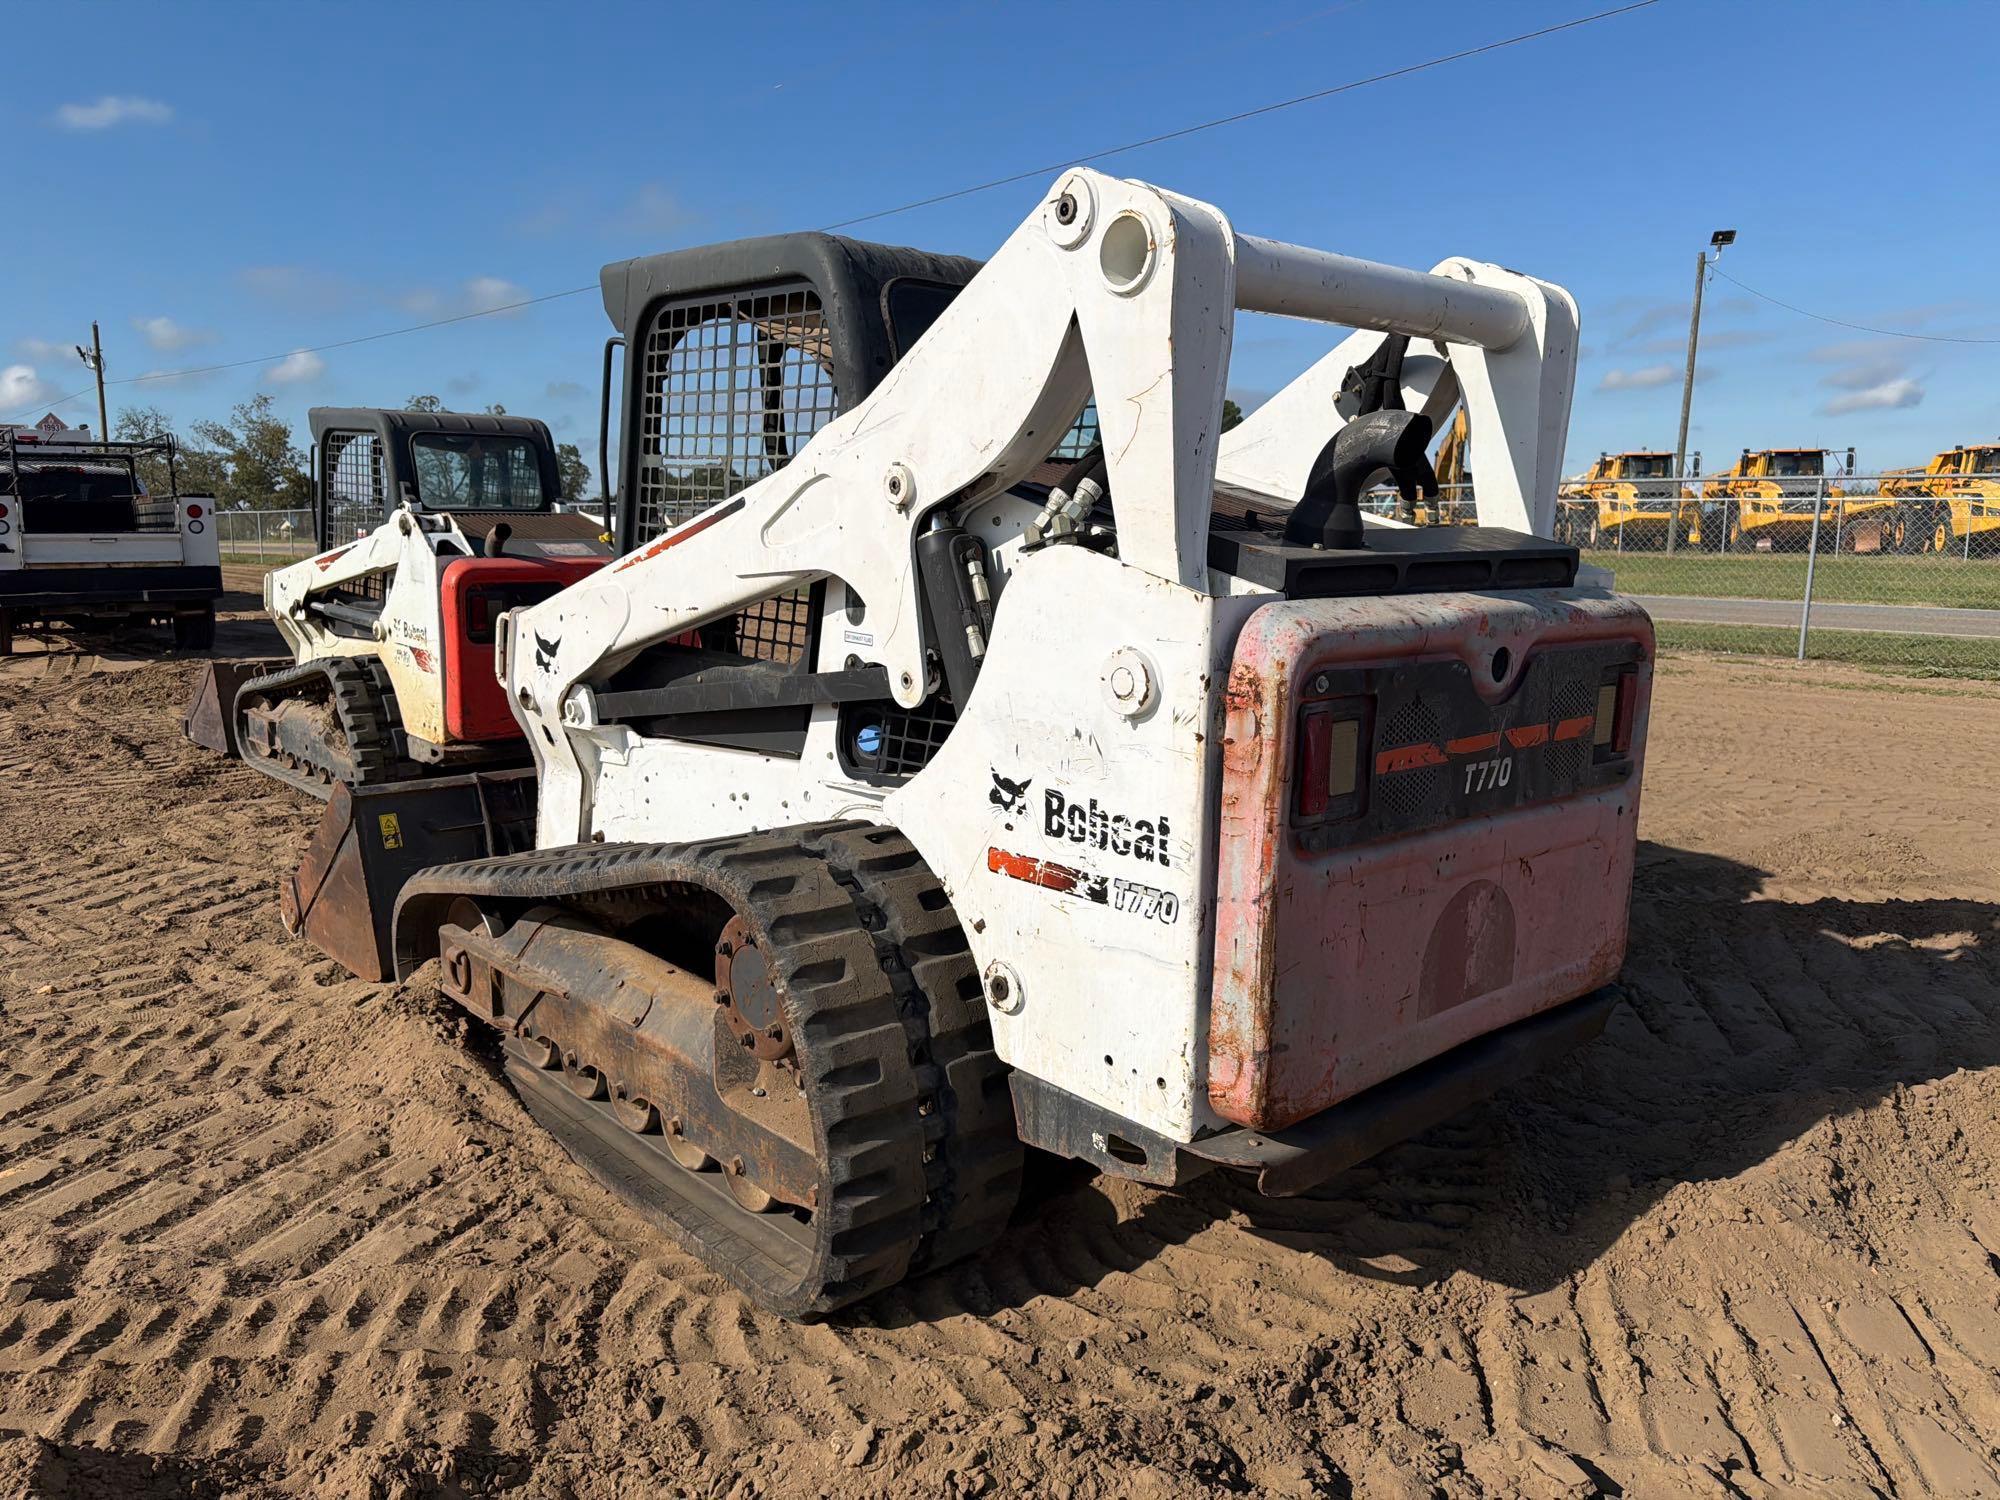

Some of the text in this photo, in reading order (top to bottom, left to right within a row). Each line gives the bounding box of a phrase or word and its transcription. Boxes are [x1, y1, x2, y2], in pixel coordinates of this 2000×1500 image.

[1464, 756, 1512, 794] T770
[1045, 788, 1171, 867] Bobcat
[1114, 878, 1179, 925] T770
